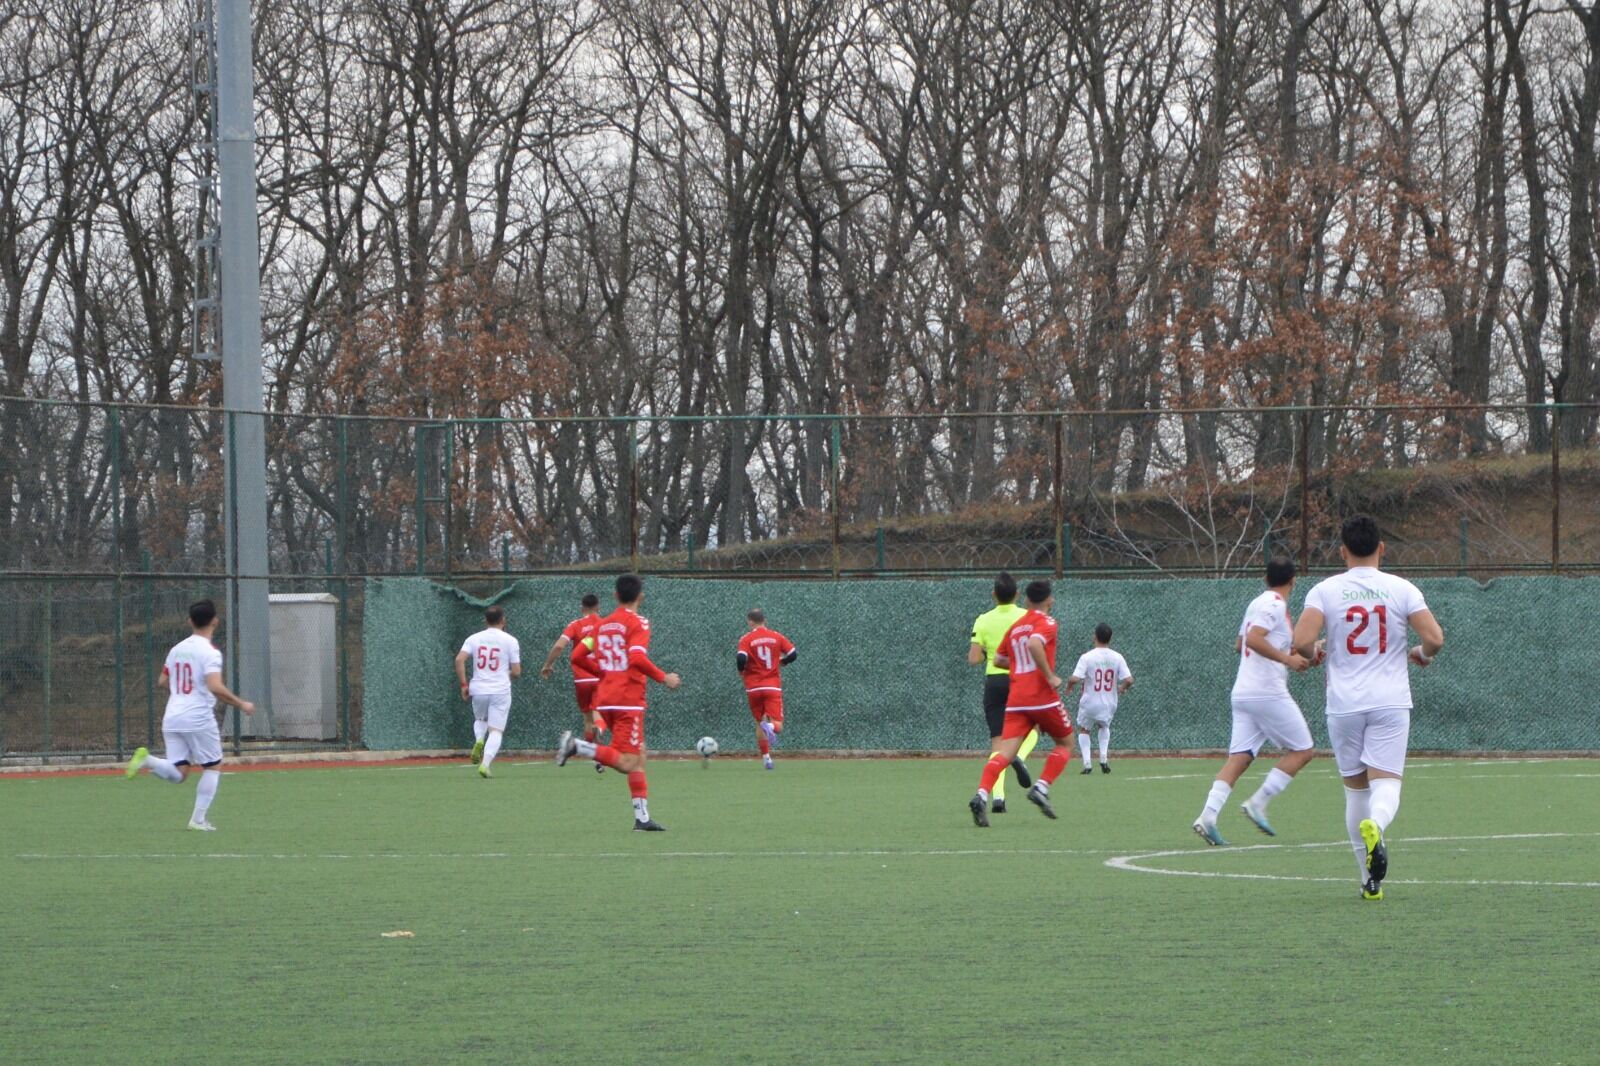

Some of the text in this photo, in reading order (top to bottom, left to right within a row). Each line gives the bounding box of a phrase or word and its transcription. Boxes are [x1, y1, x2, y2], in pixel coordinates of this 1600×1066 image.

[1346, 605, 1387, 655] 21
[478, 646, 501, 671] 55
[597, 634, 629, 672] 55
[757, 645, 772, 670] 4
[1011, 635, 1036, 675] 10
[175, 662, 192, 694] 10
[1094, 669, 1115, 692] 99
